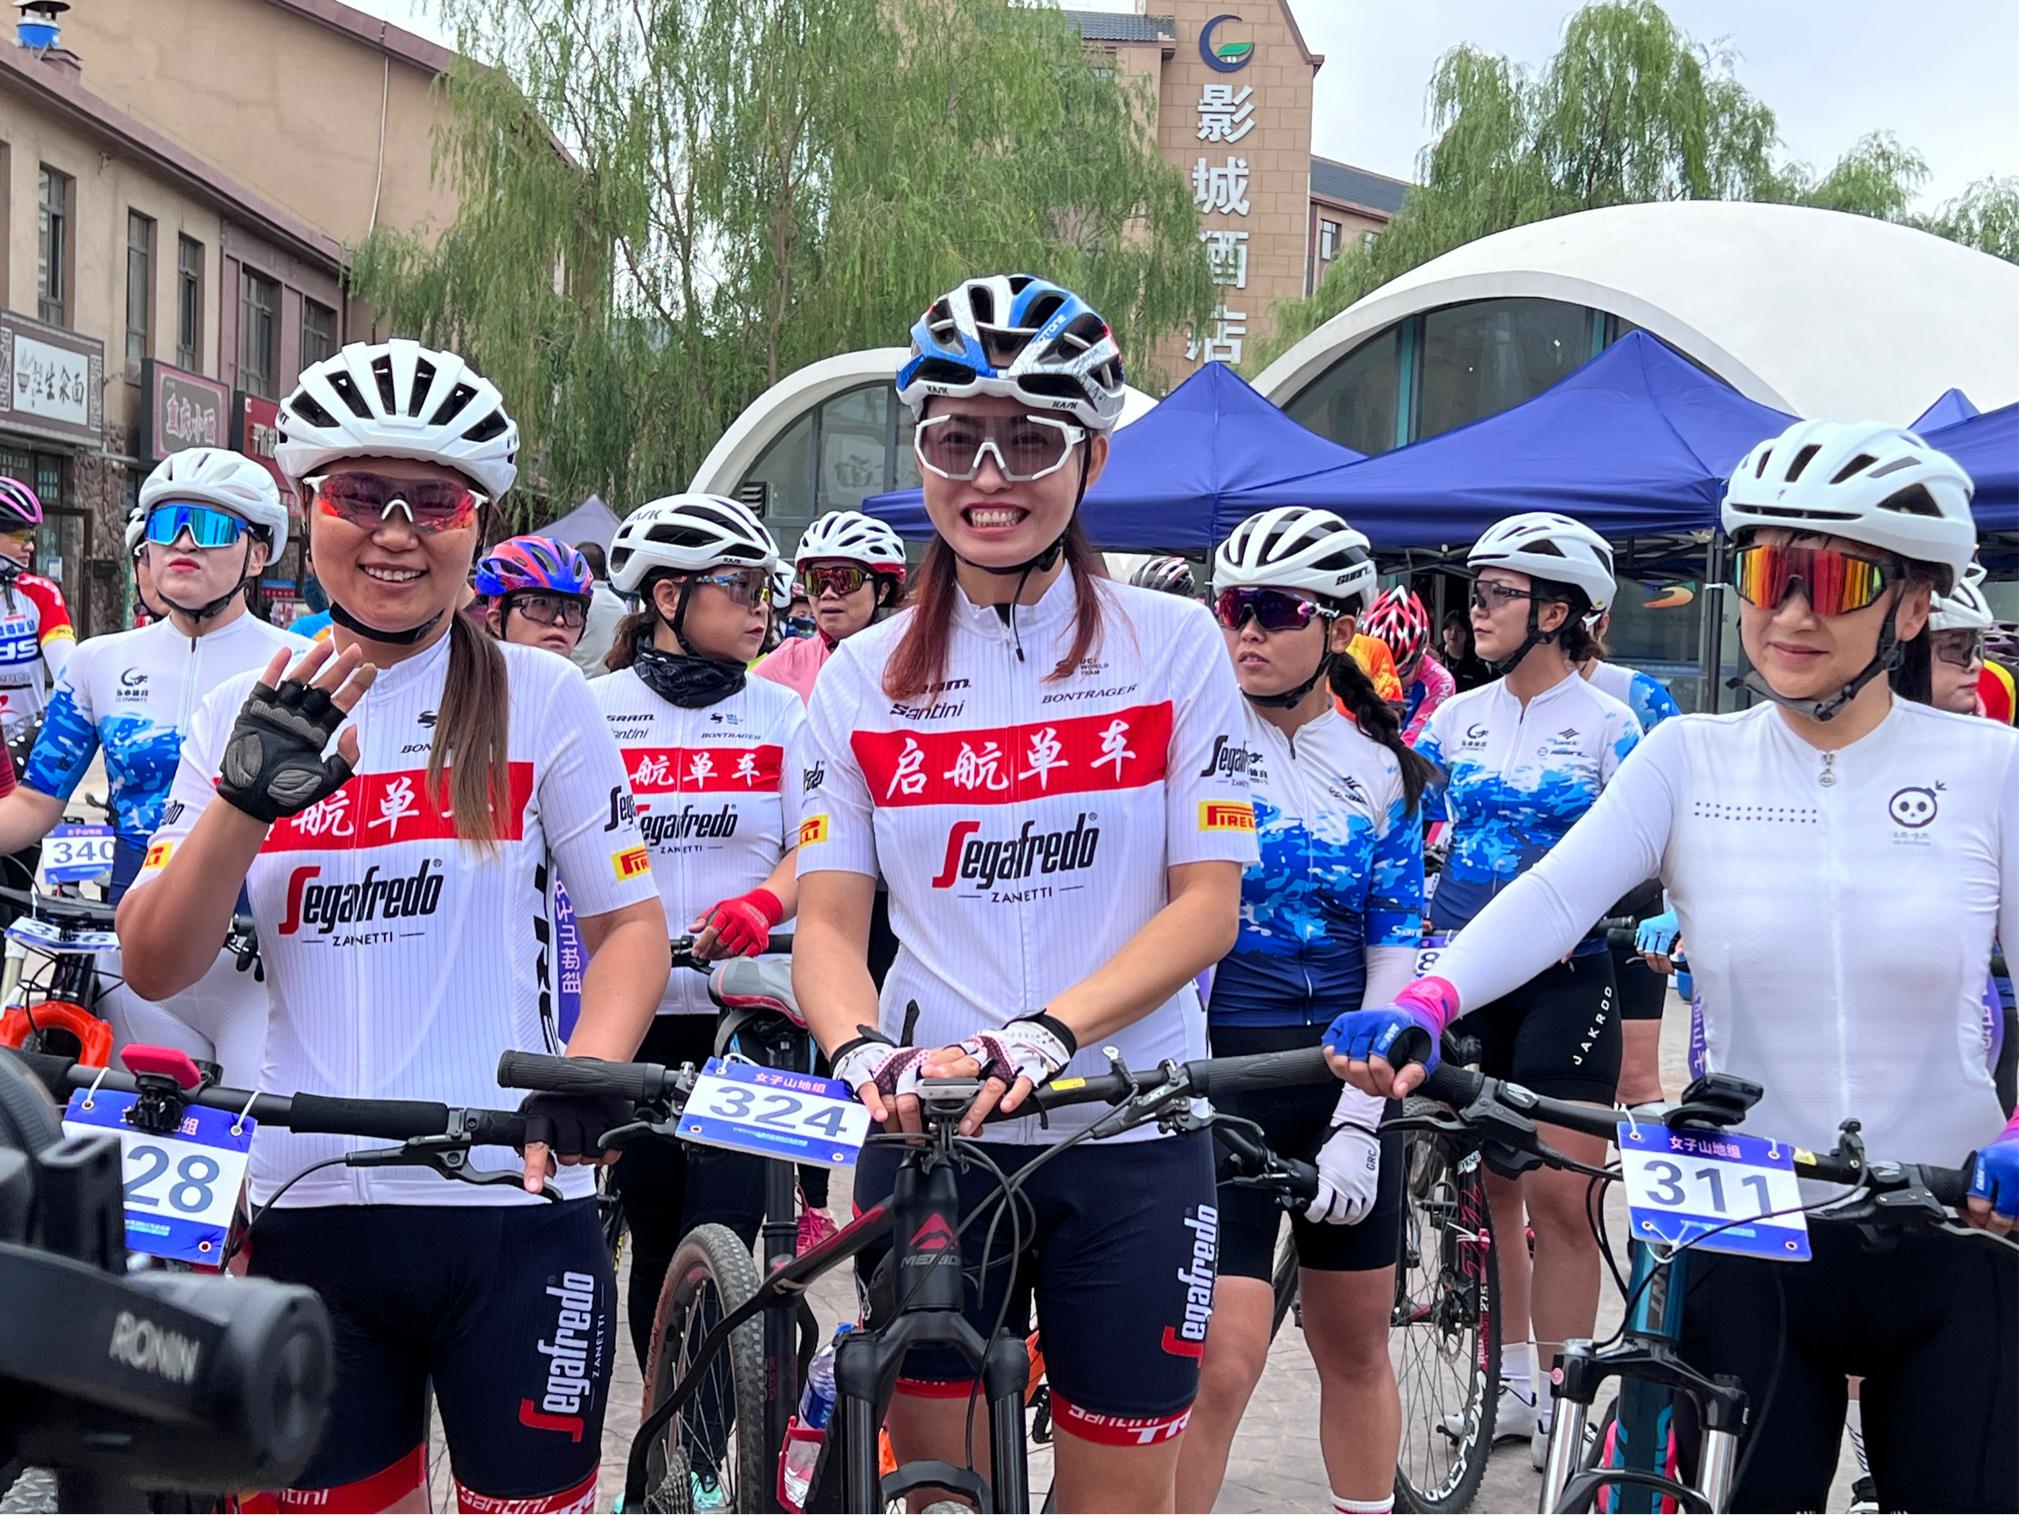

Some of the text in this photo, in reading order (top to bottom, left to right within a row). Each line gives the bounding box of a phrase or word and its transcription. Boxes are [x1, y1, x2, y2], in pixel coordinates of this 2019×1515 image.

[1185, 84, 1256, 365] 影城酒店
[889, 700, 965, 720] Santini
[1041, 683, 1138, 704] BONTRAGER
[611, 728, 649, 739] antini
[629, 752, 761, 789] 航单车
[886, 719, 1137, 800] 启航单车
[635, 803, 738, 846] egafredo
[1207, 805, 1256, 829] PIREL
[53, 840, 114, 864] 340
[932, 813, 1098, 889] Segafredo
[278, 858, 444, 935] Segafredo
[991, 886, 1053, 904] ZANETTI
[333, 931, 394, 947] ZANETTI
[754, 1072, 827, 1095] 女子山地组
[709, 1086, 848, 1137] 324
[1669, 1136, 1743, 1159] 女子山地组
[123, 1145, 220, 1214] 28
[1643, 1160, 1773, 1216] 311
[1160, 1204, 1218, 1368] Segafredo
[518, 1271, 595, 1443] Segafredo
[592, 1313, 606, 1379] ZANETTI
